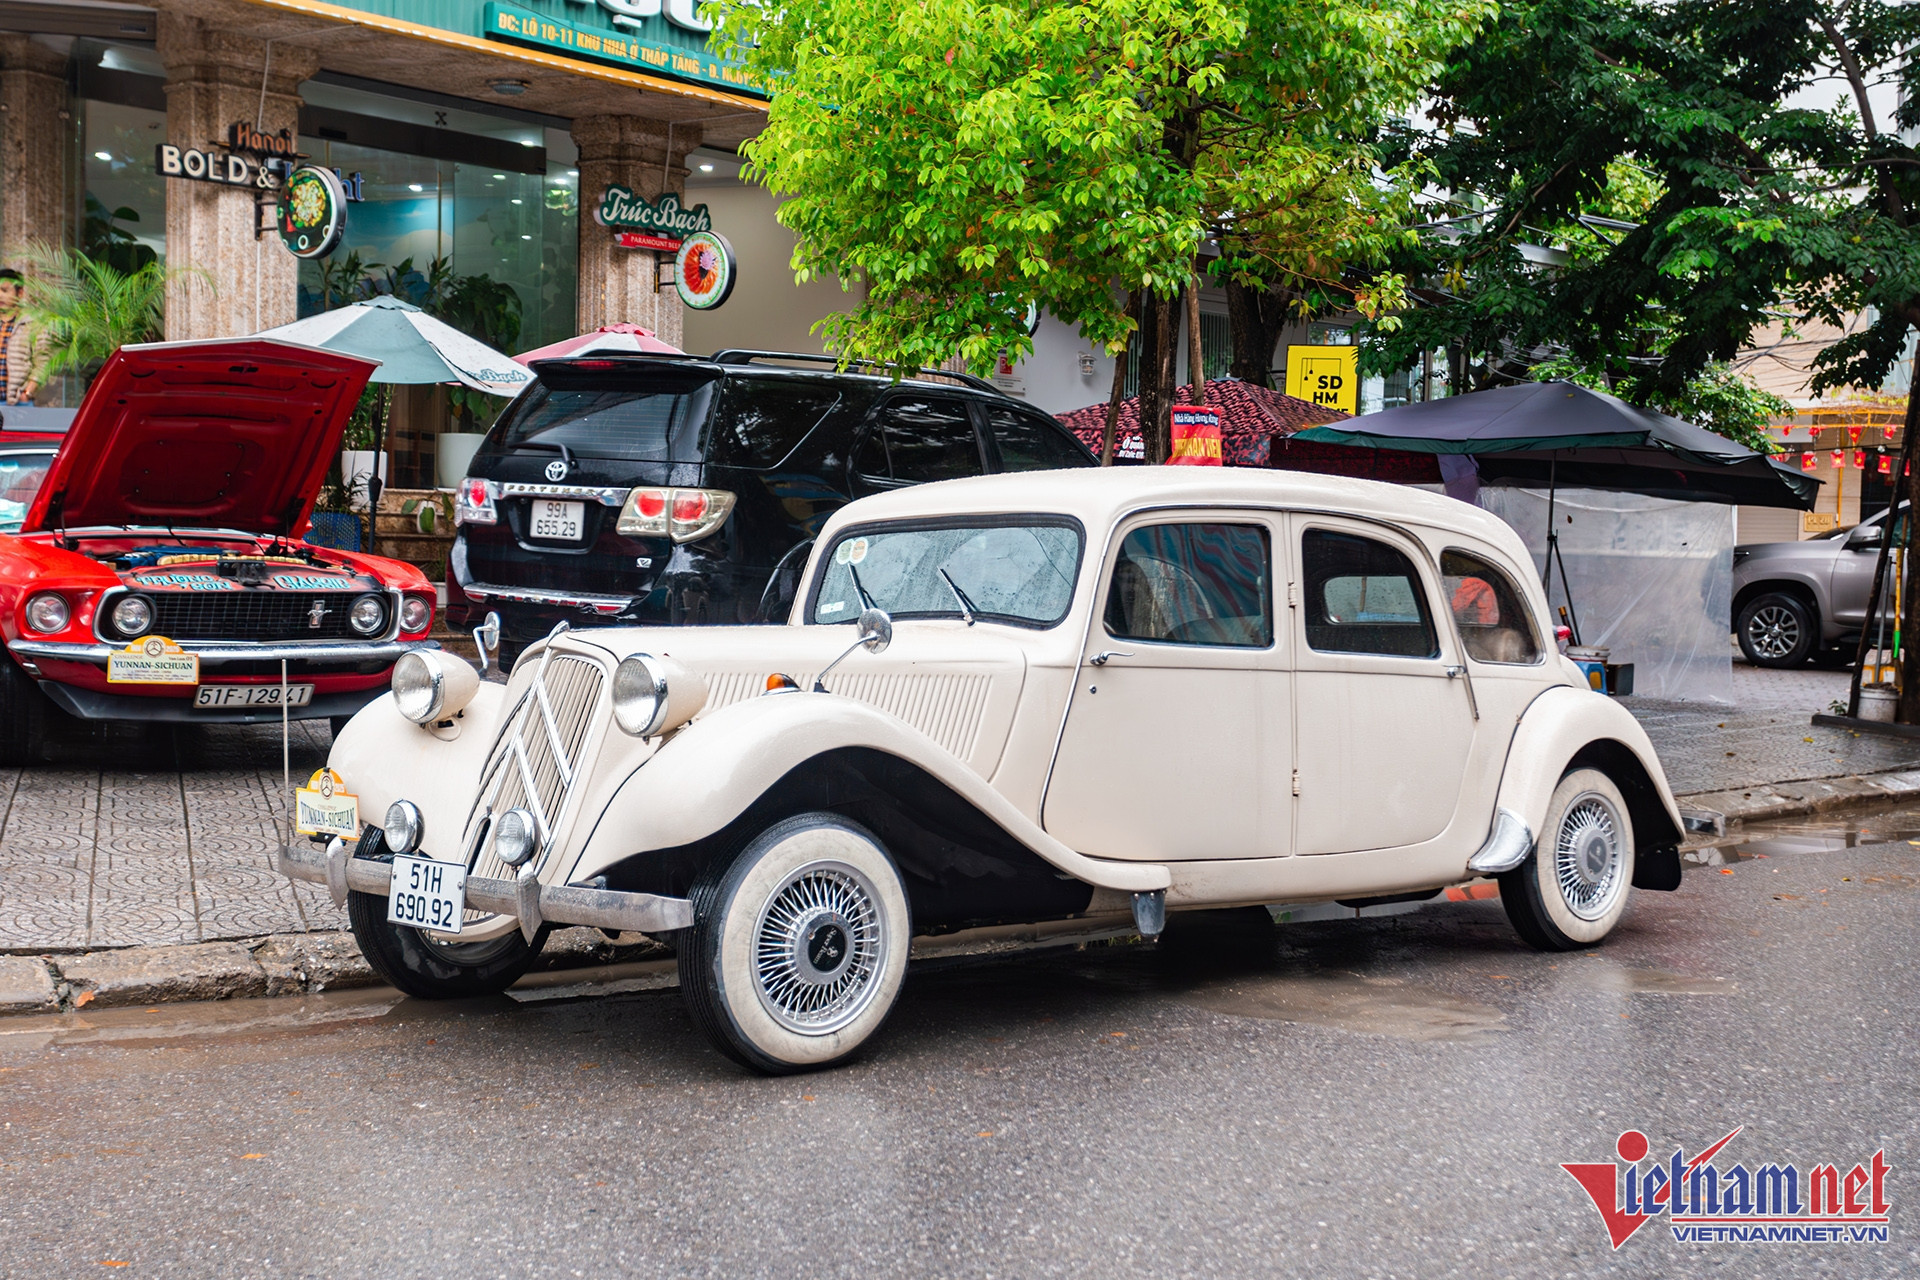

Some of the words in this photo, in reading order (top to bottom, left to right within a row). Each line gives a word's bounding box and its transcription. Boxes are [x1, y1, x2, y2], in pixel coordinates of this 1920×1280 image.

[522, 17, 538, 36] LÔ
[541, 23, 573, 45] 10-11
[576, 31, 601, 51] KHU
[237, 123, 292, 154] Hanoi
[162, 145, 249, 184] BOLD
[256, 166, 274, 188] &
[602, 188, 651, 223] Trúc
[653, 197, 709, 232] Bạch
[630, 235, 667, 249] PARAMOUNT
[1318, 375, 1343, 389] SD
[1313, 391, 1338, 404] HM
[507, 485, 597, 496] FORTUNER
[546, 502, 568, 518] 99A
[536, 519, 577, 537] 655.29
[410, 863, 443, 893] 51H
[395, 892, 453, 927] 690.92
